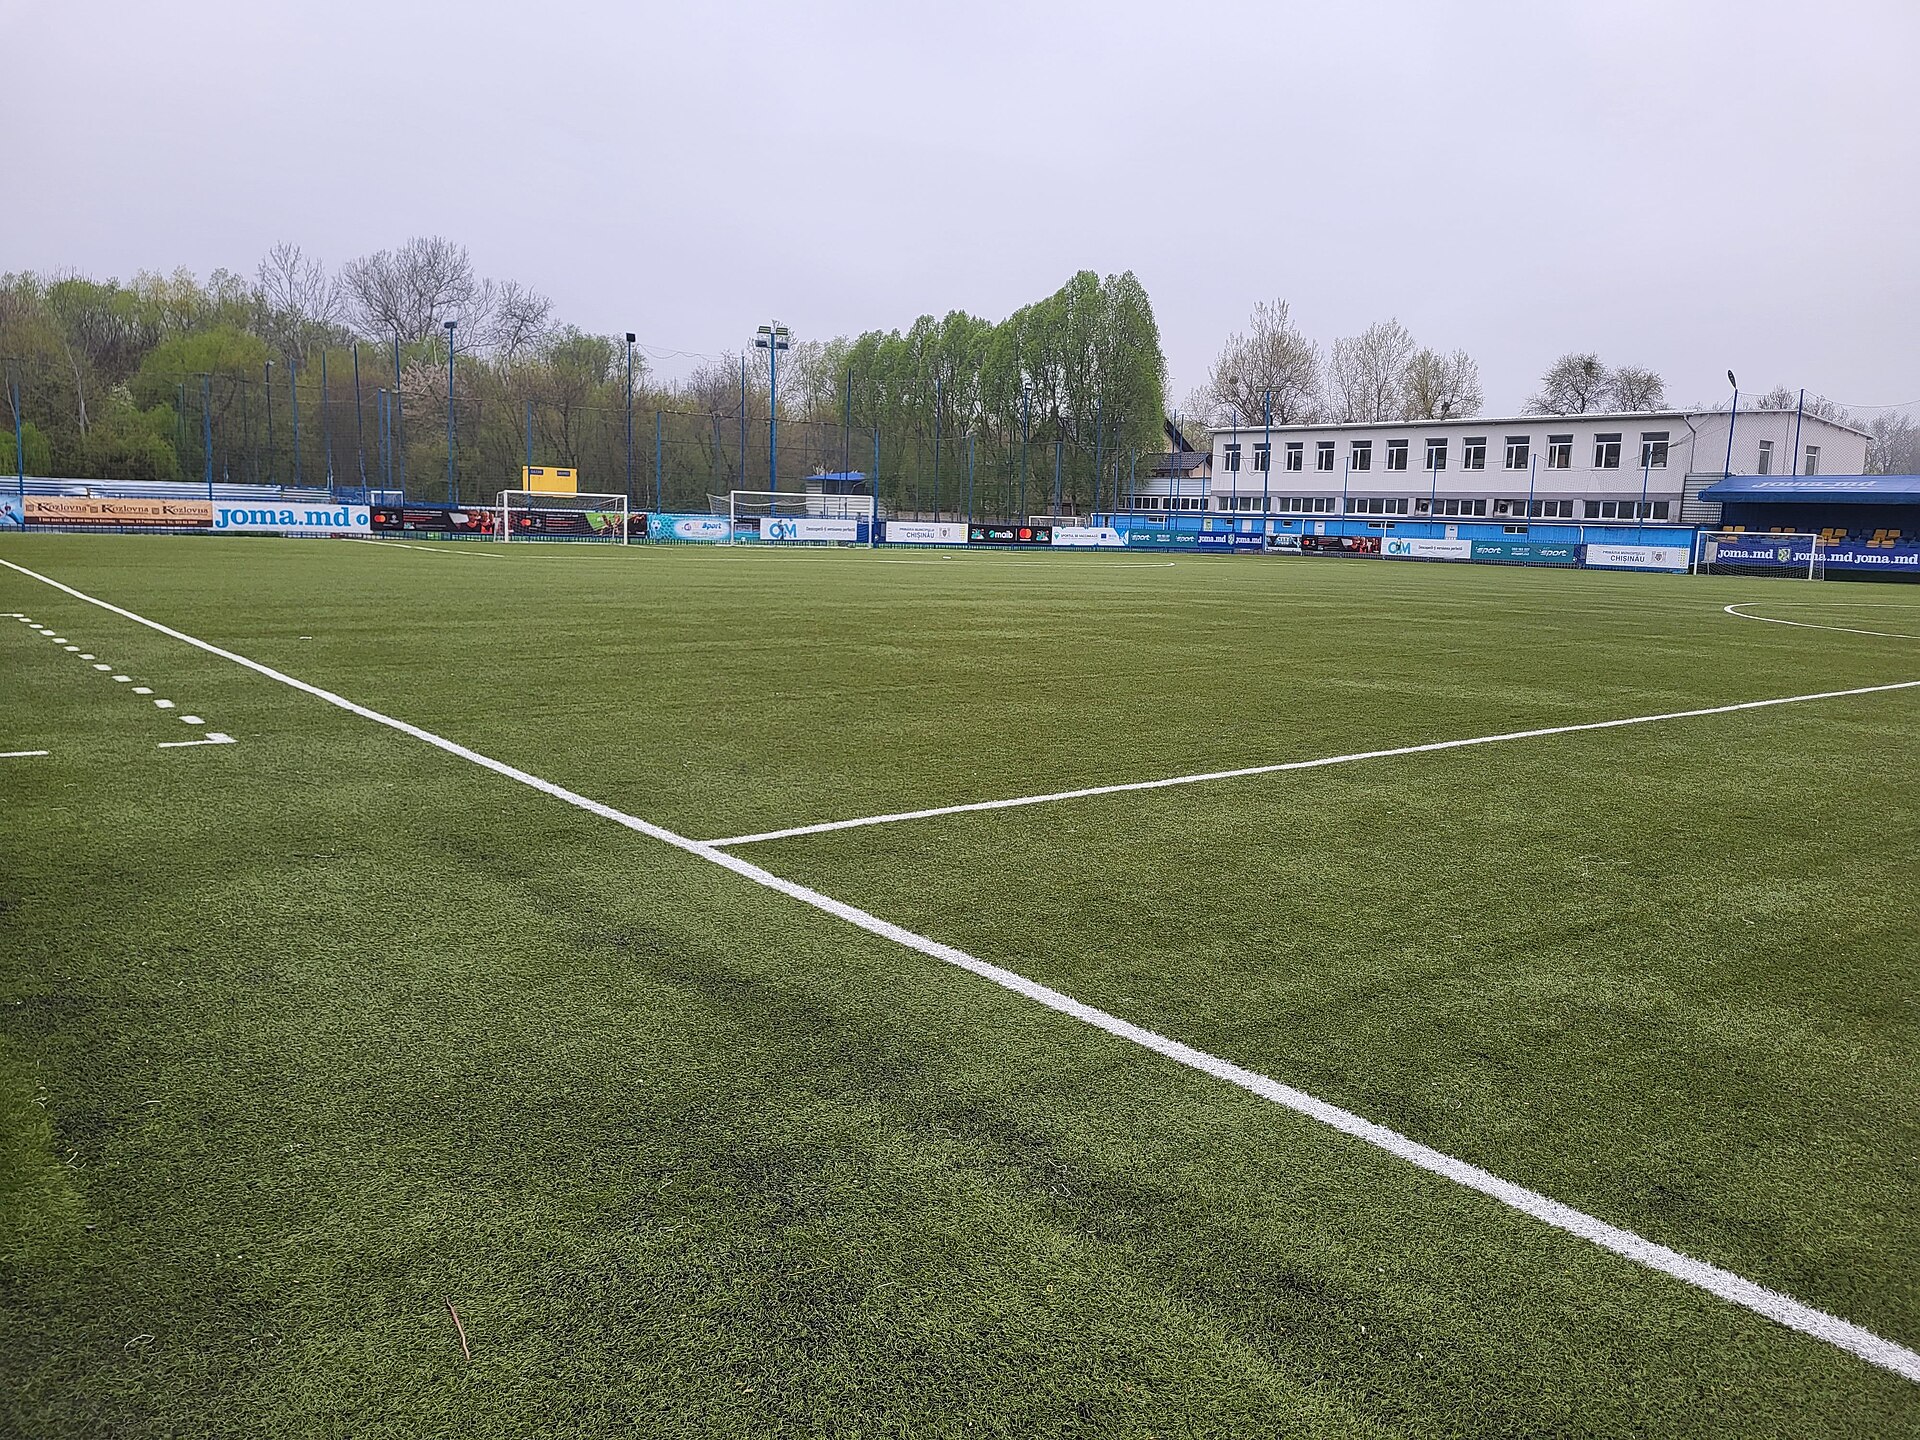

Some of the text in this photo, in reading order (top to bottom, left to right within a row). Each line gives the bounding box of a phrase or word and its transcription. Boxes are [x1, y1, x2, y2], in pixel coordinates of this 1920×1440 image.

[37, 502, 88, 513] Kozlovna
[102, 504, 149, 515] Kozlovna
[162, 505, 209, 516] Kozlovna
[994, 530, 1014, 539] maib
